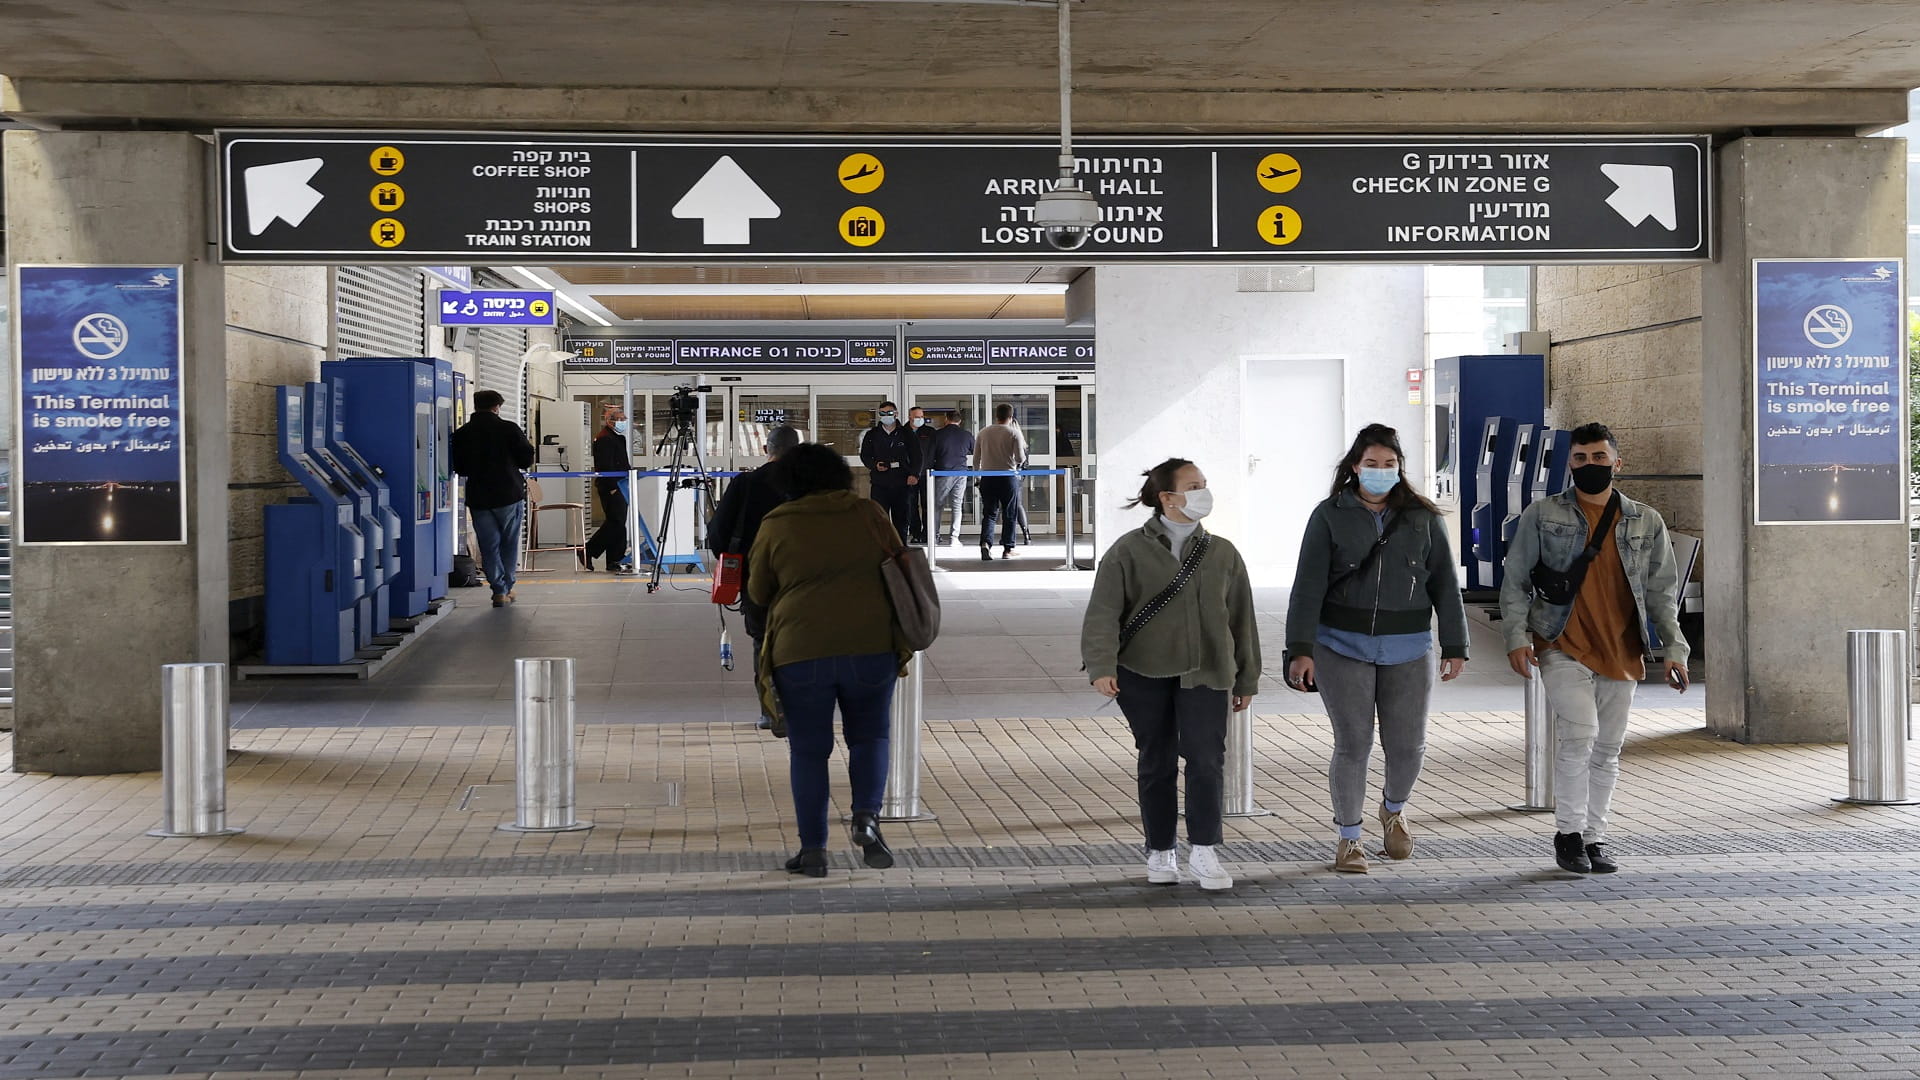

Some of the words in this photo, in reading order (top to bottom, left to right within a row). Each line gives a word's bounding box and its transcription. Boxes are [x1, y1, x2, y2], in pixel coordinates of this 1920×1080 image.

[512, 150, 553, 165] קפה
[558, 150, 591, 163] בית
[1403, 154, 1420, 170] G
[1500, 154, 1550, 170] אזור
[1073, 158, 1163, 174] נחיתות
[1428, 154, 1494, 174] בידוק
[473, 166, 539, 178] COFFEE
[545, 166, 591, 178] SHOP
[984, 179, 1091, 194] ARRIVL
[1100, 179, 1164, 194] HALL
[1352, 177, 1432, 193] CHECK
[1438, 177, 1459, 193] IN
[1465, 177, 1528, 193] ZONE
[1533, 177, 1551, 193] G
[536, 186, 591, 199] חנויות
[534, 201, 591, 214] SHOPS
[1469, 202, 1550, 223] מודיעין
[485, 219, 534, 232] רכבת
[540, 219, 591, 232] תחנת
[981, 227, 1046, 243] LOST
[1387, 225, 1551, 242] INFORMATION
[466, 234, 516, 247] TRAIN
[521, 234, 591, 247] STATION
[482, 298, 525, 309] כניסה
[680, 346, 762, 358] ENTRANCE
[795, 347, 842, 358] כניסה
[991, 347, 1067, 357] ENTRANCE
[1767, 356, 1803, 371] עישון
[1806, 355, 1831, 368] ללא
[1834, 356, 1842, 368] 3
[1846, 355, 1889, 368] טרמינל
[32, 367, 73, 384] עישון
[76, 366, 106, 381] ללא
[108, 368, 117, 381] 3
[120, 366, 170, 381] טרמינל
[1768, 382, 1805, 395] This
[1808, 381, 1889, 395] Terminal
[33, 395, 75, 409] This
[80, 395, 170, 409] Terminal
[1768, 399, 1782, 413] is
[1787, 399, 1846, 413] smoke
[1851, 399, 1889, 413] free
[33, 413, 49, 428] is
[55, 413, 122, 428] smoke
[128, 413, 171, 428] free
[1767, 425, 1801, 436] تدخين
[1806, 426, 1833, 436] بدون
[33, 440, 72, 452] تدخين
[76, 441, 107, 453] بدون
